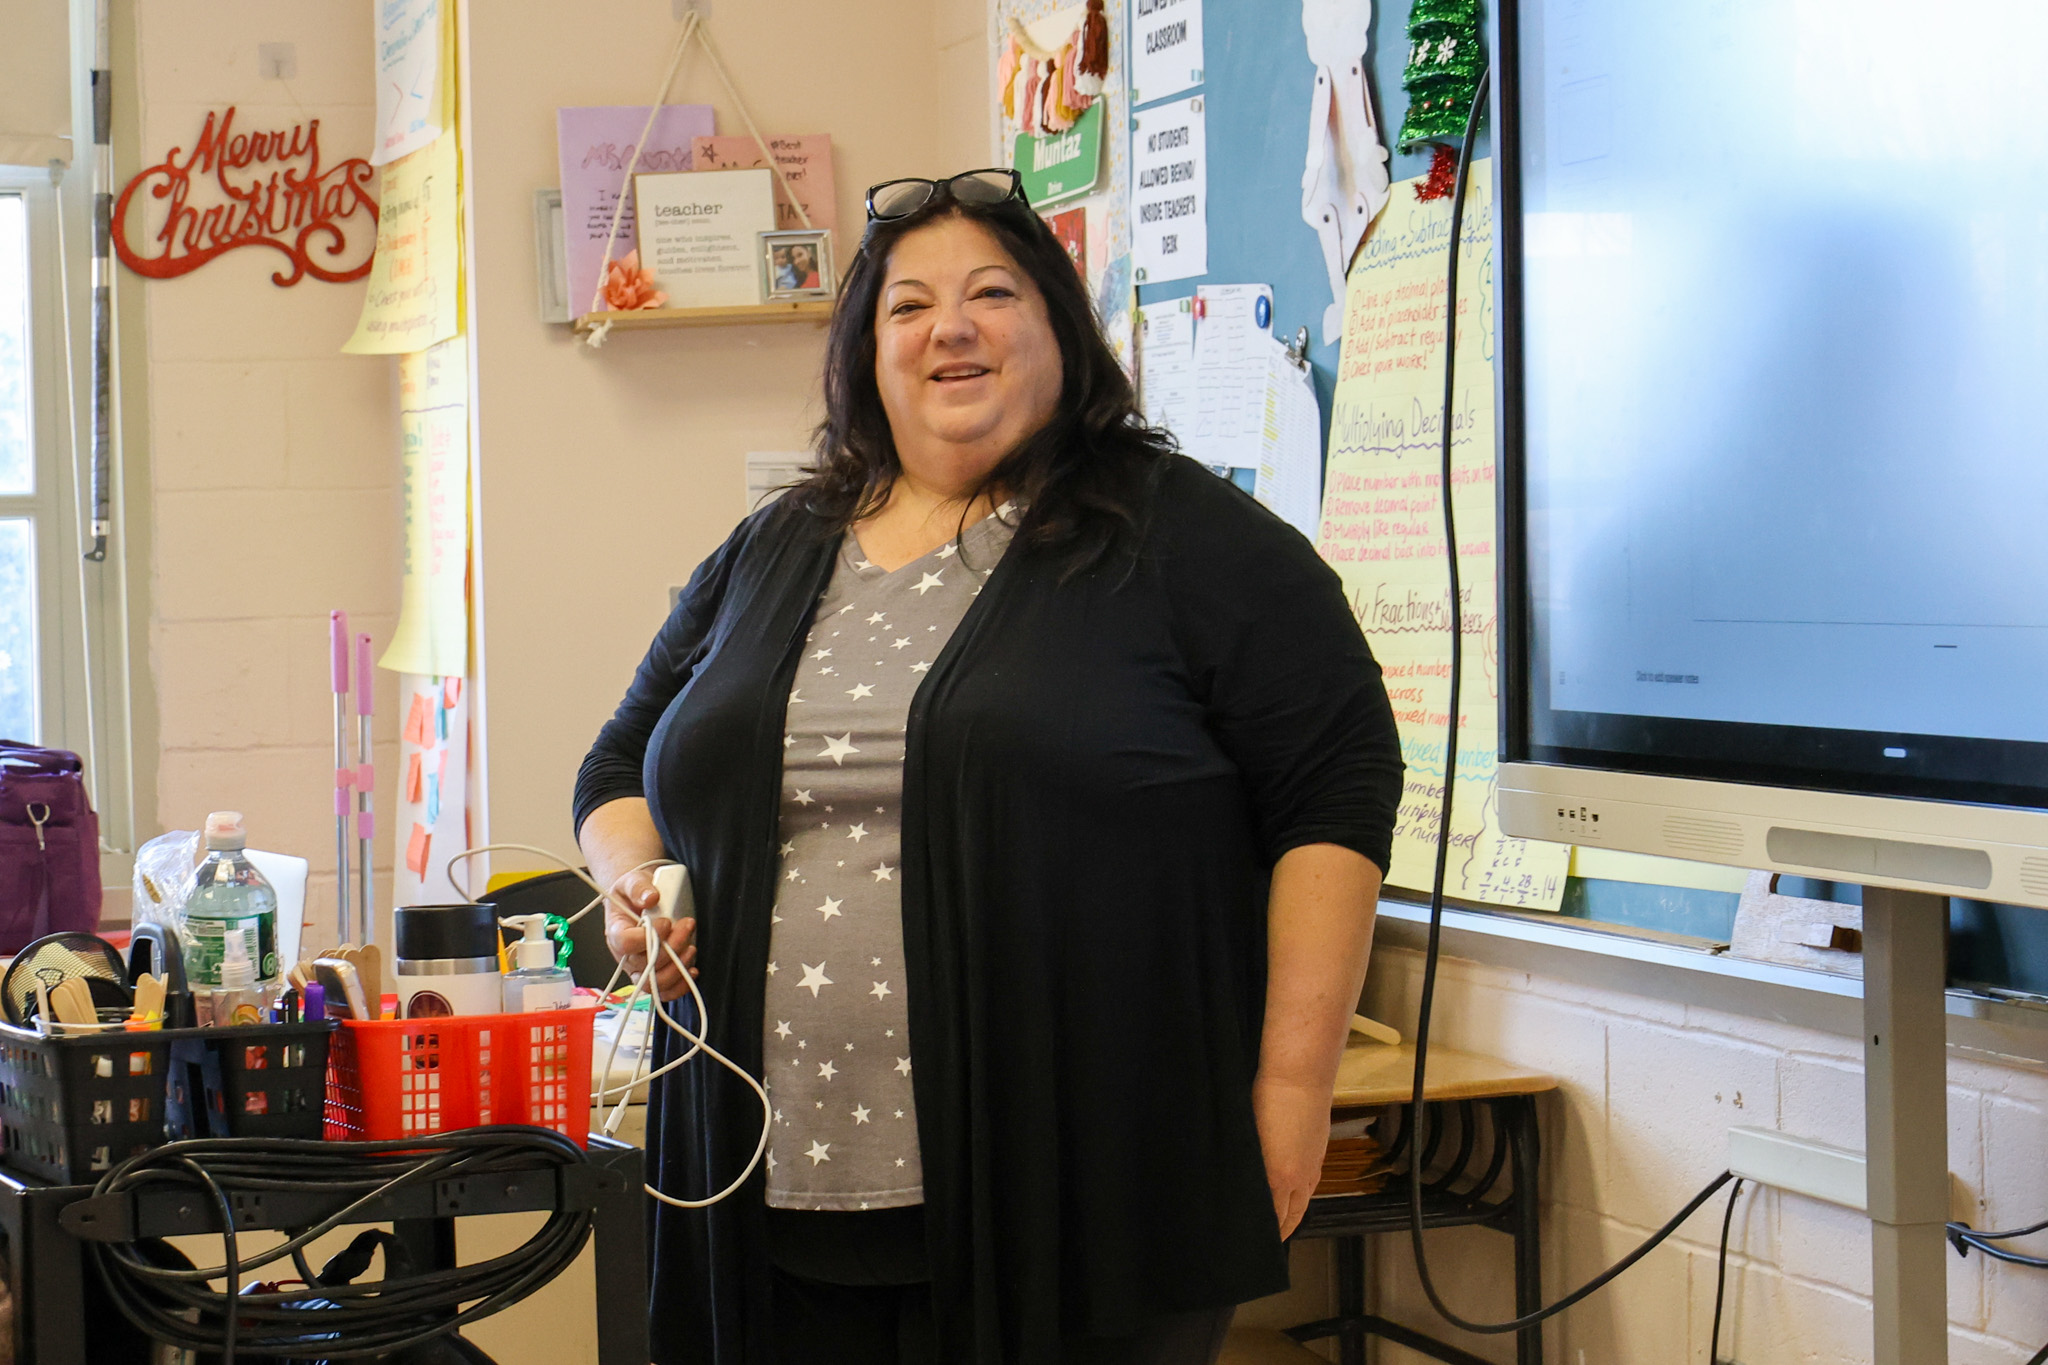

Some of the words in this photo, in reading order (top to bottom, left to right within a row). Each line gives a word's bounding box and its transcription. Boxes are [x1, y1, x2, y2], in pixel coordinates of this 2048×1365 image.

[1146, 20, 1187, 54] CLASSROOM
[172, 106, 319, 198] Merry
[1033, 133, 1081, 172] Muntaz
[1147, 133, 1157, 154] NO
[1158, 125, 1189, 151] STUDENTS
[1139, 166, 1168, 190] ALLOWED
[111, 158, 380, 287] Christmas
[655, 203, 723, 217] teacher
[1140, 202, 1162, 224] INSIDE
[1333, 401, 1405, 459] Multiplying
[1387, 687, 1424, 703] across
